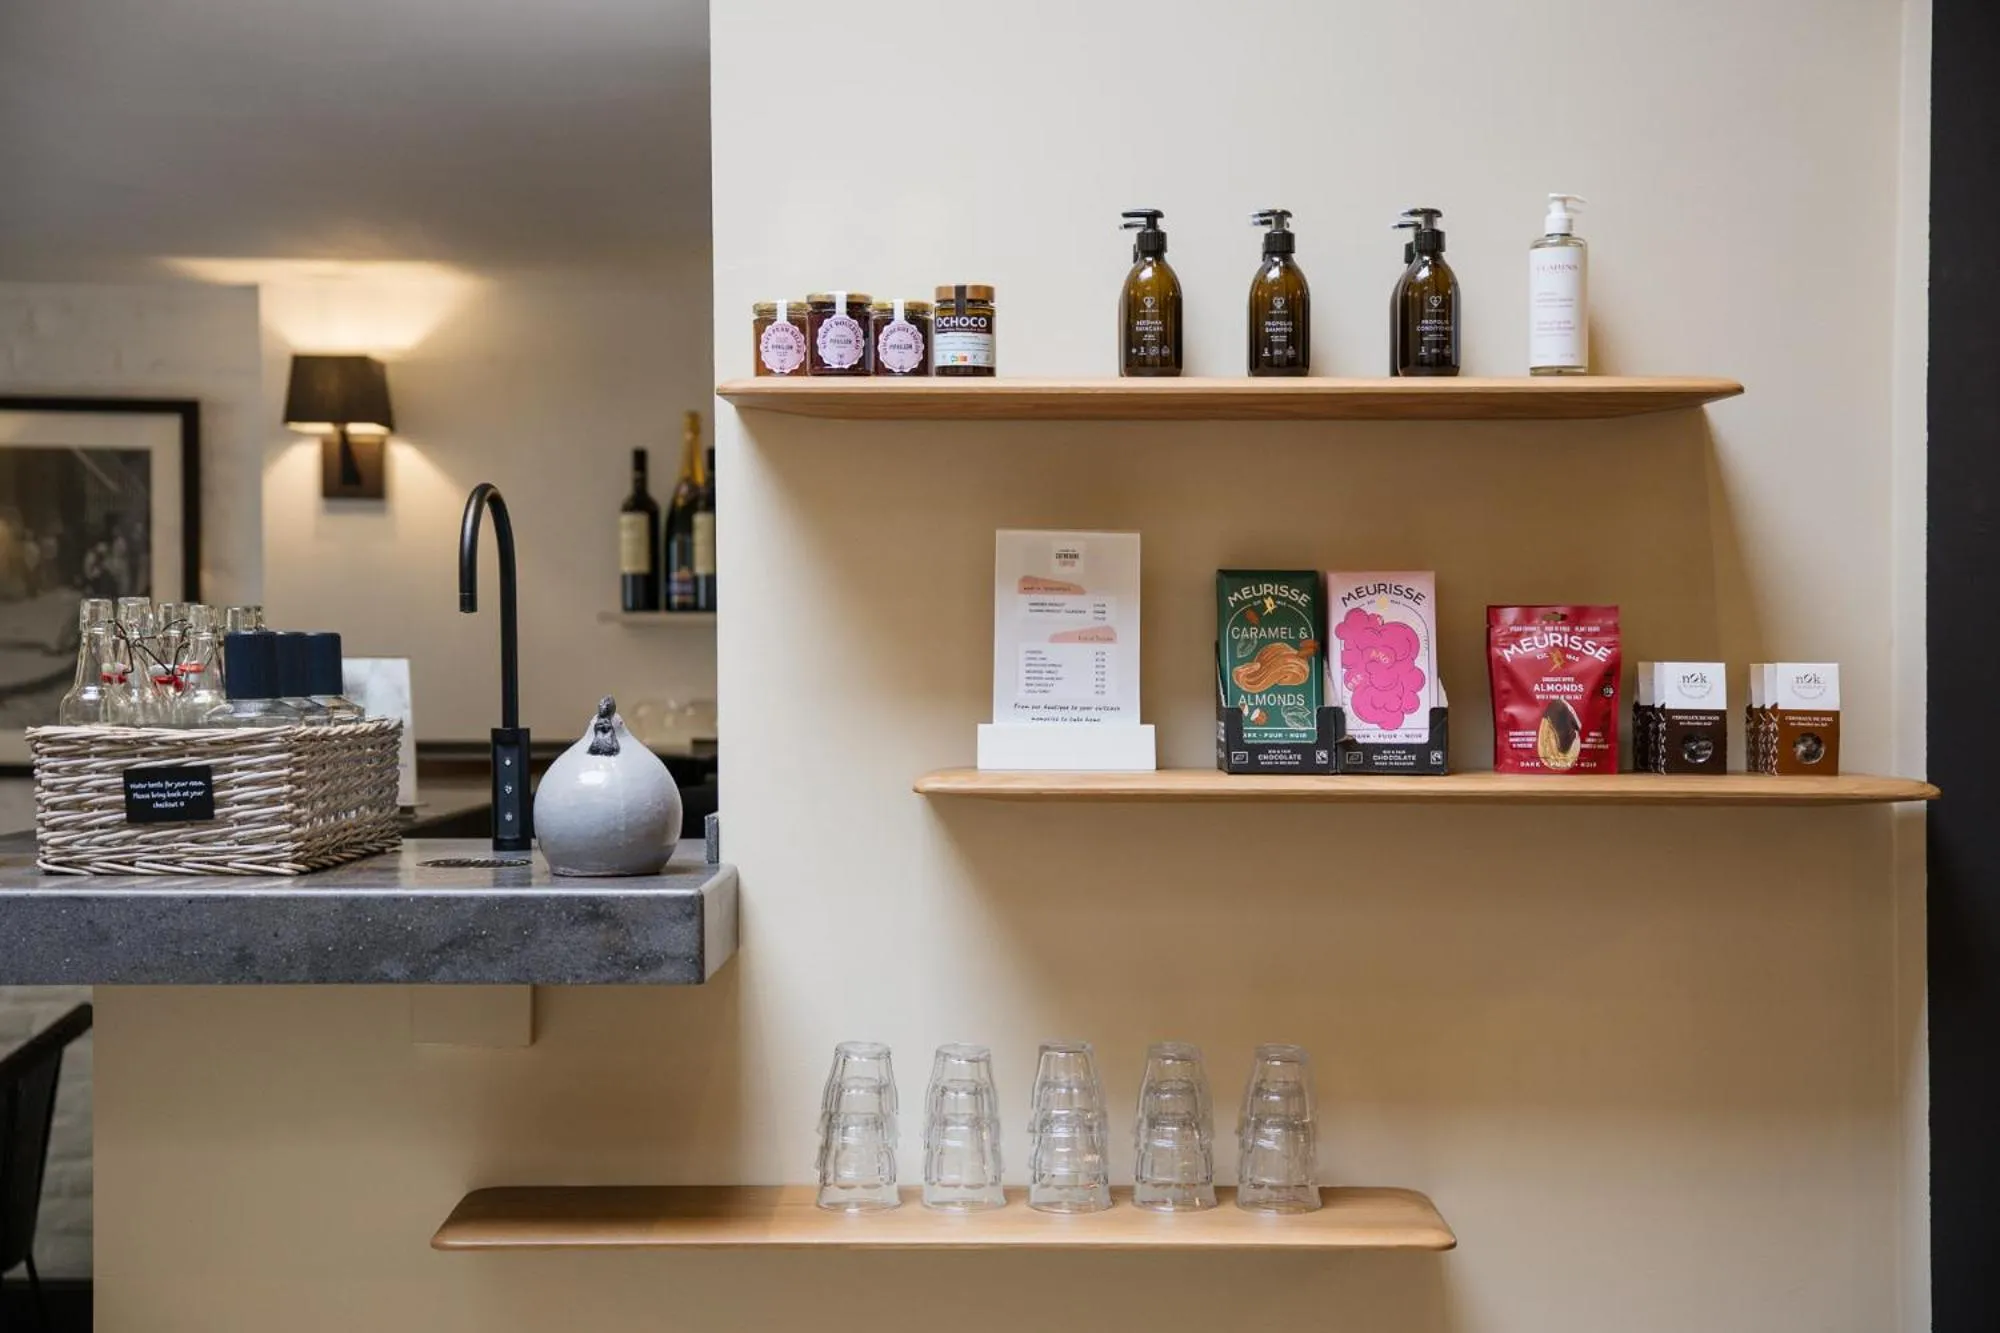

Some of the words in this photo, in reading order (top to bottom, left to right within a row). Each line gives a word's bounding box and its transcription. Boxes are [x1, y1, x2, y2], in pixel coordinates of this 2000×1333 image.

[1227, 583, 1311, 607] MEURISSE
[1341, 583, 1427, 607] MEURISSE
[1231, 627, 1295, 640] CARAMEL
[1300, 627, 1309, 640] &
[1503, 632, 1612, 662] MEURISSE
[1534, 684, 1585, 693] ALMONDS
[1239, 694, 1305, 706] ALMONDS
